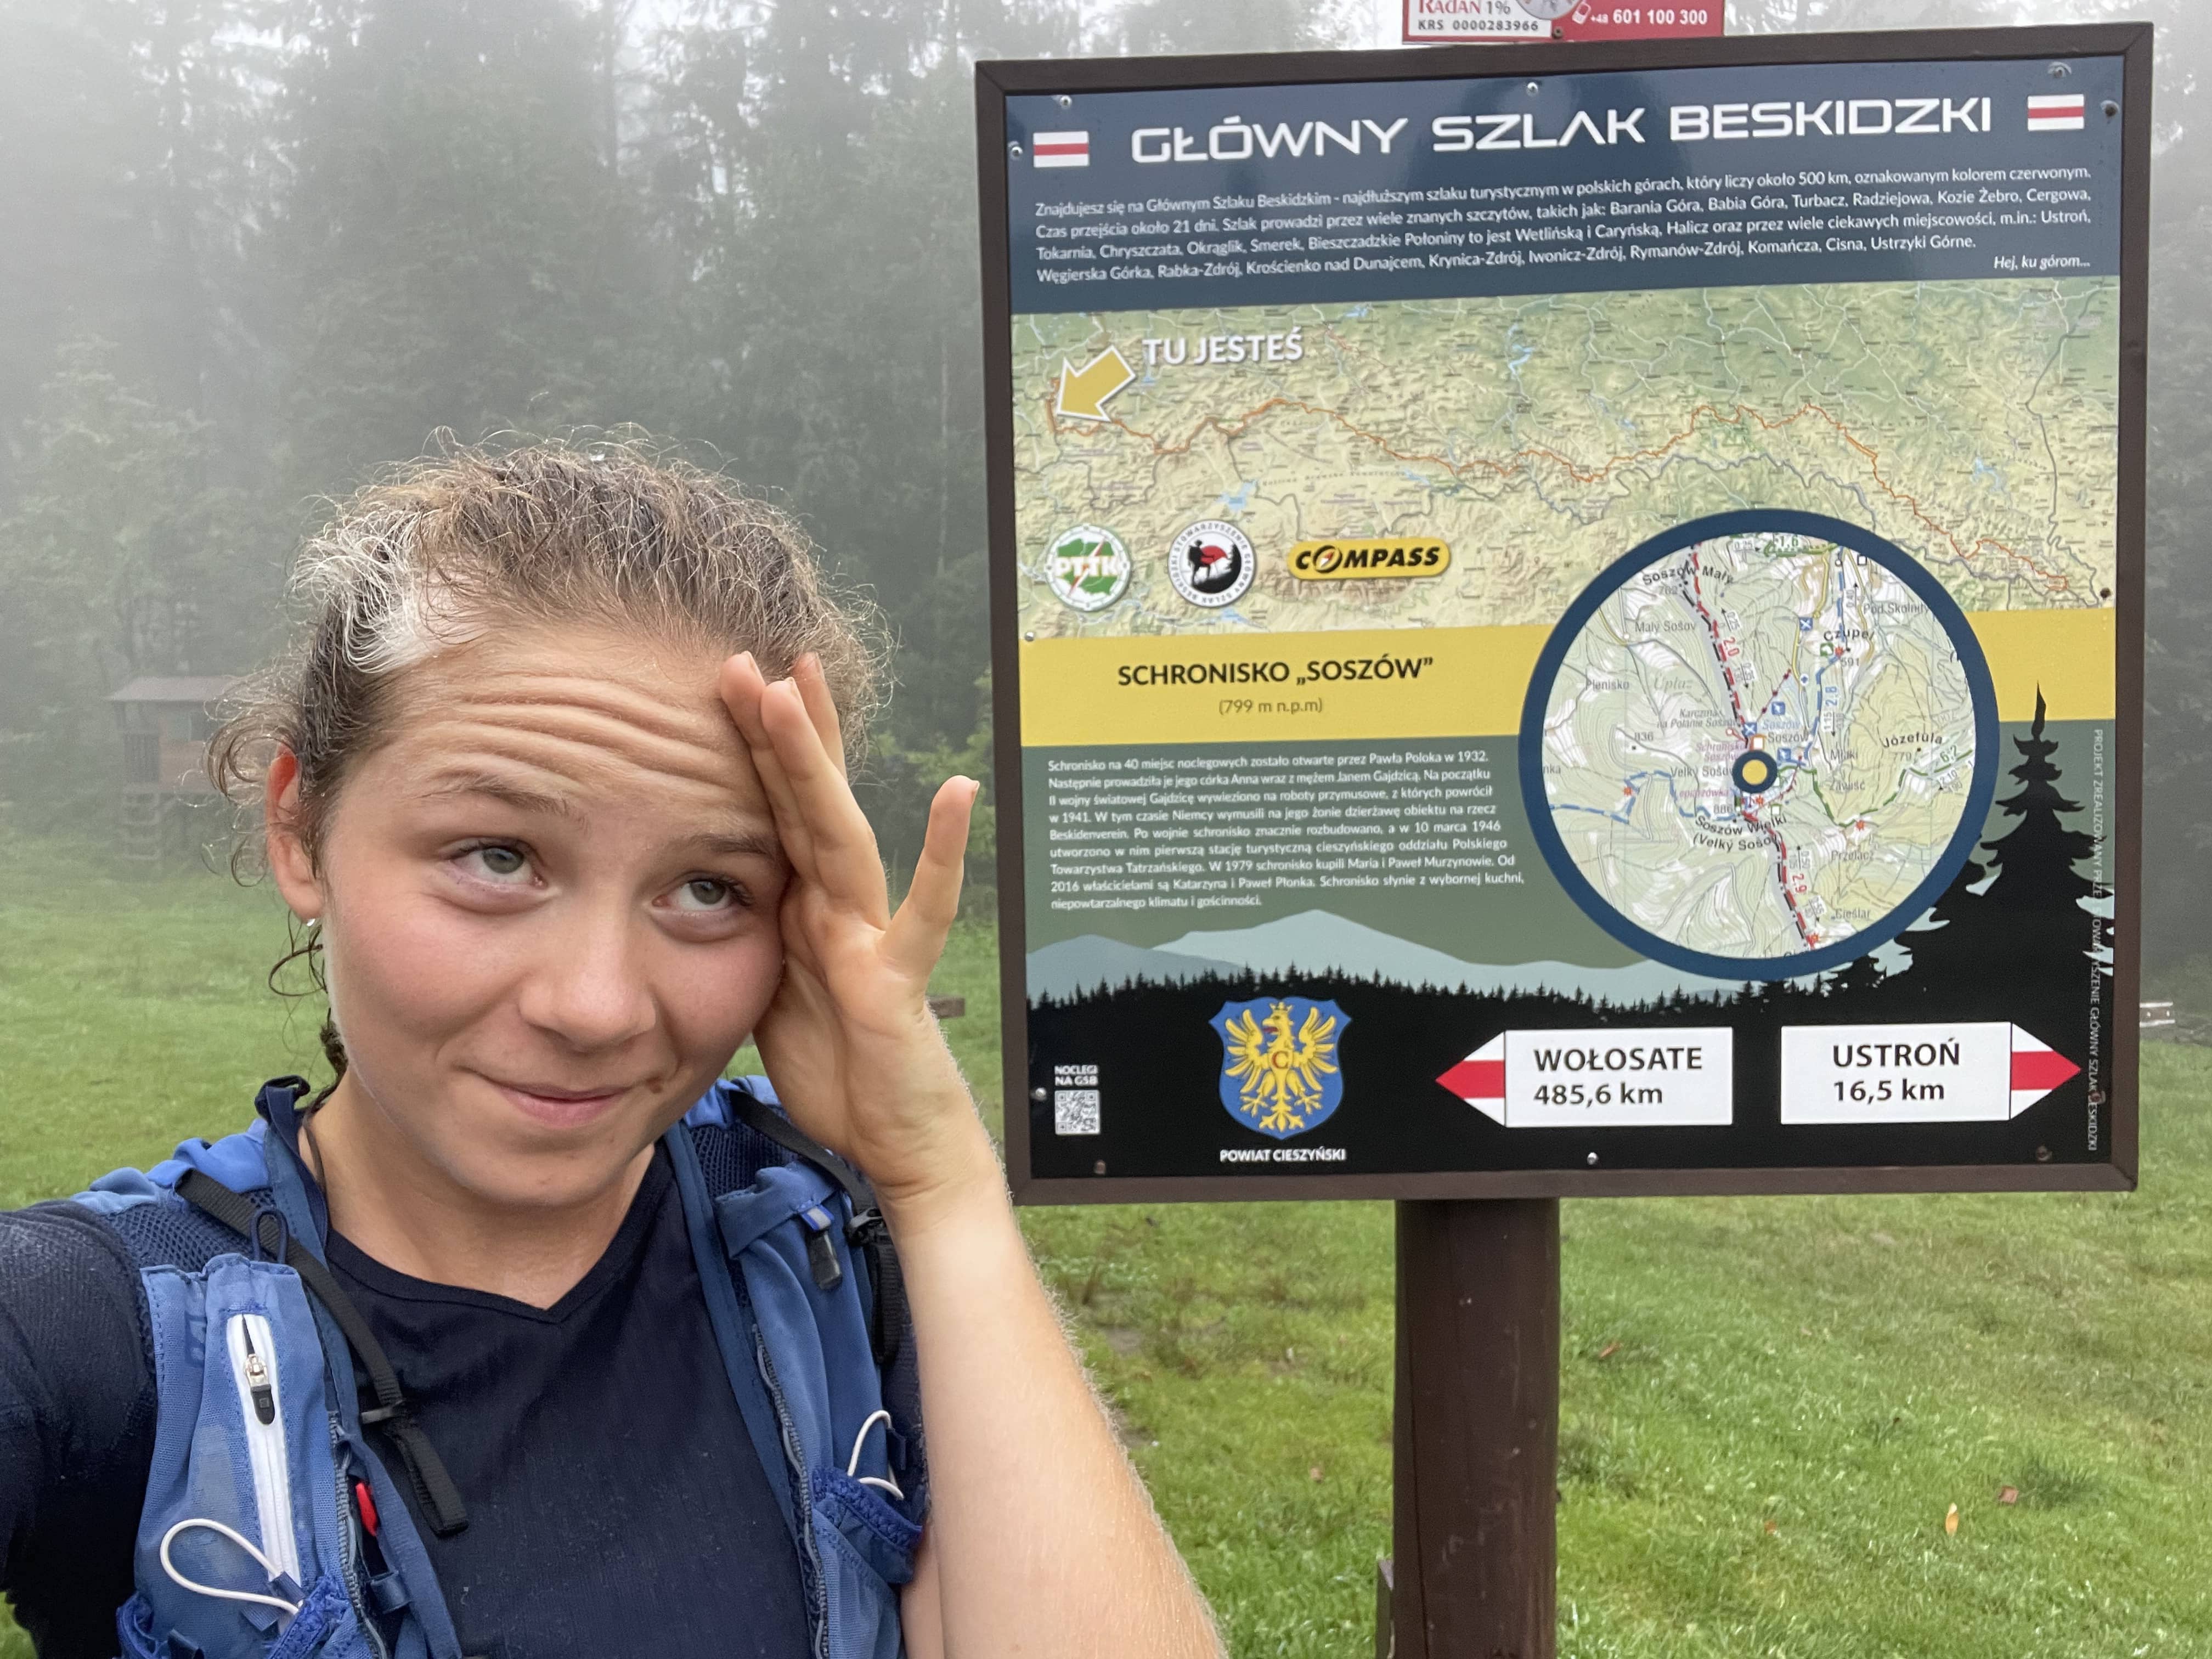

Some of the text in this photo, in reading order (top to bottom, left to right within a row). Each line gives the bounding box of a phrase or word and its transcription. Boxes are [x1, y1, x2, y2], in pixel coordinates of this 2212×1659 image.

[1487, 1, 1511, 14] 1%
[1612, 8, 1641, 24] 601
[1646, 9, 1675, 25] 100
[1679, 8, 1708, 25] 300
[1418, 19, 1539, 32] KRS 0000283966
[1132, 97, 1991, 163] GŁÓWNY SZLAK BESKIDZKI
[1035, 199, 1104, 218] Znajdujesz
[1107, 198, 1125, 215] się
[1127, 200, 1144, 211] na
[1146, 195, 1210, 214] Głównym
[1213, 194, 1255, 208] Szlaku
[1257, 191, 1331, 206] Beskidzkim
[1342, 188, 1424, 207] najdłuższym
[1426, 187, 1468, 200] szlaku
[1470, 183, 1560, 202] turystycznym
[1561, 185, 1575, 196] w
[1576, 180, 1632, 199] polskich
[1686, 177, 1723, 195] który
[1725, 176, 1754, 194] liczy
[1757, 175, 1796, 189] około
[1798, 174, 1826, 188] 500
[1854, 170, 1949, 189] oznakowanym
[1952, 167, 2006, 182] kolorem
[1036, 222, 1068, 236] Czas
[1070, 220, 1128, 239] przejścia
[1131, 219, 1170, 233] około
[1173, 218, 1190, 232] 21
[1222, 216, 1257, 230] Szlak
[1261, 214, 1323, 232] prowadzi
[1326, 215, 1363, 230] przez
[1366, 211, 1403, 225] wiele
[1406, 209, 1463, 228] znanych
[1536, 205, 1578, 219] takich
[1610, 202, 1662, 217] Barania
[1708, 200, 1747, 213] Babia
[1938, 192, 1975, 206] Kozie
[1308, 233, 1401, 249] Bieszczadzkie
[1404, 231, 1465, 250] Połoniny
[1468, 230, 1483, 244] to
[1486, 229, 1511, 246] jest
[1515, 227, 1583, 246] Wetlińską
[1587, 227, 1592, 239] i
[1667, 222, 1709, 236] Halicz
[1712, 224, 1743, 235] oraz
[1746, 223, 1784, 238] przez
[1787, 218, 1824, 232] wiele
[1827, 216, 1899, 235] ciekawych
[1036, 265, 1107, 284] Węgierska
[1246, 257, 1322, 272] Krościenko
[1324, 256, 1350, 269] nad
[1871, 235, 1926, 254] Ustrzyki
[2021, 253, 2037, 266] ku
[1143, 326, 1304, 366] TU JESTEŚ
[1053, 555, 1119, 578] PTTK
[1295, 545, 1441, 574] COMPASS
[1118, 653, 1434, 686] SCHRONISKO „SOSZÓW”
[1841, 658, 1859, 667] 591
[1218, 697, 1323, 715] (799 m n.p.m)
[1048, 757, 1107, 770] Schronisko
[1108, 760, 1122, 769] na
[1124, 757, 1139, 769] 40
[1141, 756, 1175, 771] miejsc
[1177, 754, 1249, 770] noclegowych
[1250, 754, 1290, 766] zostało
[1291, 753, 1335, 765] otwarte
[1337, 755, 1367, 767] przez
[1369, 752, 1403, 764] Pawła
[1405, 751, 1442, 763] Poloka
[1444, 753, 1455, 762] w
[2094, 729, 2104, 777] PROJEKT
[1696, 815, 1742, 835] Soszów
[2092, 780, 2104, 867] ZREALIZOWANY
[1051, 896, 1147, 912] niepowtarzalnego
[1148, 895, 1189, 907] klimatu
[1190, 895, 1195, 907] i
[2089, 1007, 2101, 1057] GŁÓWNY
[1272, 1050, 1289, 1070] C
[1534, 1047, 1702, 1072] WOŁOSATE
[1832, 1037, 1960, 1068] USTROŃ
[1055, 1075, 1073, 1086] NA
[1833, 1077, 1945, 1105] 16,5 km
[1534, 1081, 1663, 1108] 485,6 km
[1219, 1144, 1346, 1163] POWIAT CIESZYŃSKI
